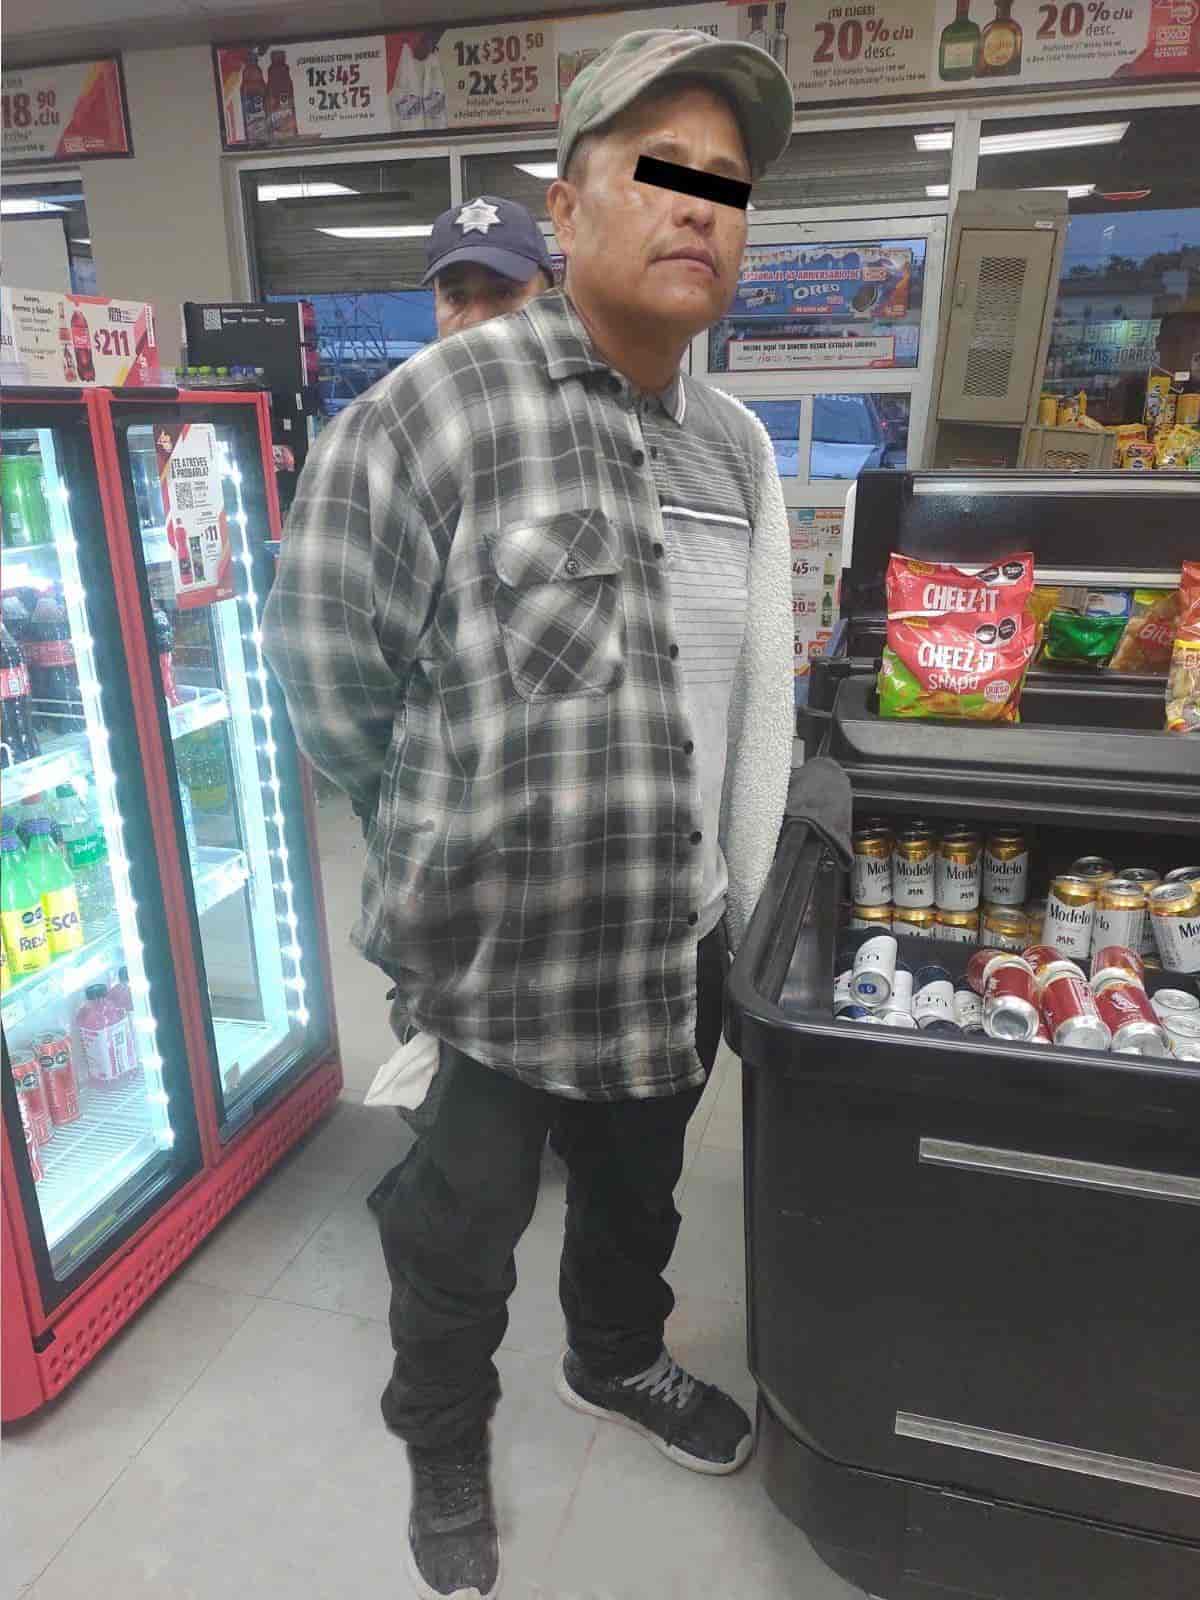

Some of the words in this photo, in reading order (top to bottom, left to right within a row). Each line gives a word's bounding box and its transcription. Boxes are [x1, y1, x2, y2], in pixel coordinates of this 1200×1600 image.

[1036, 2, 1110, 40] 20%
[1113, 8, 1133, 20] c/u
[813, 19, 889, 63] 20%
[893, 25, 914, 40] c/u
[865, 45, 895, 60] desc.
[306, 64, 360, 87] 1x$45
[469, 66, 538, 96] 2x$55
[317, 86, 370, 110] 2x$75
[793, 283, 840, 300] OREO
[95, 329, 130, 357] $211
[1049, 903, 1091, 925] Modelo
